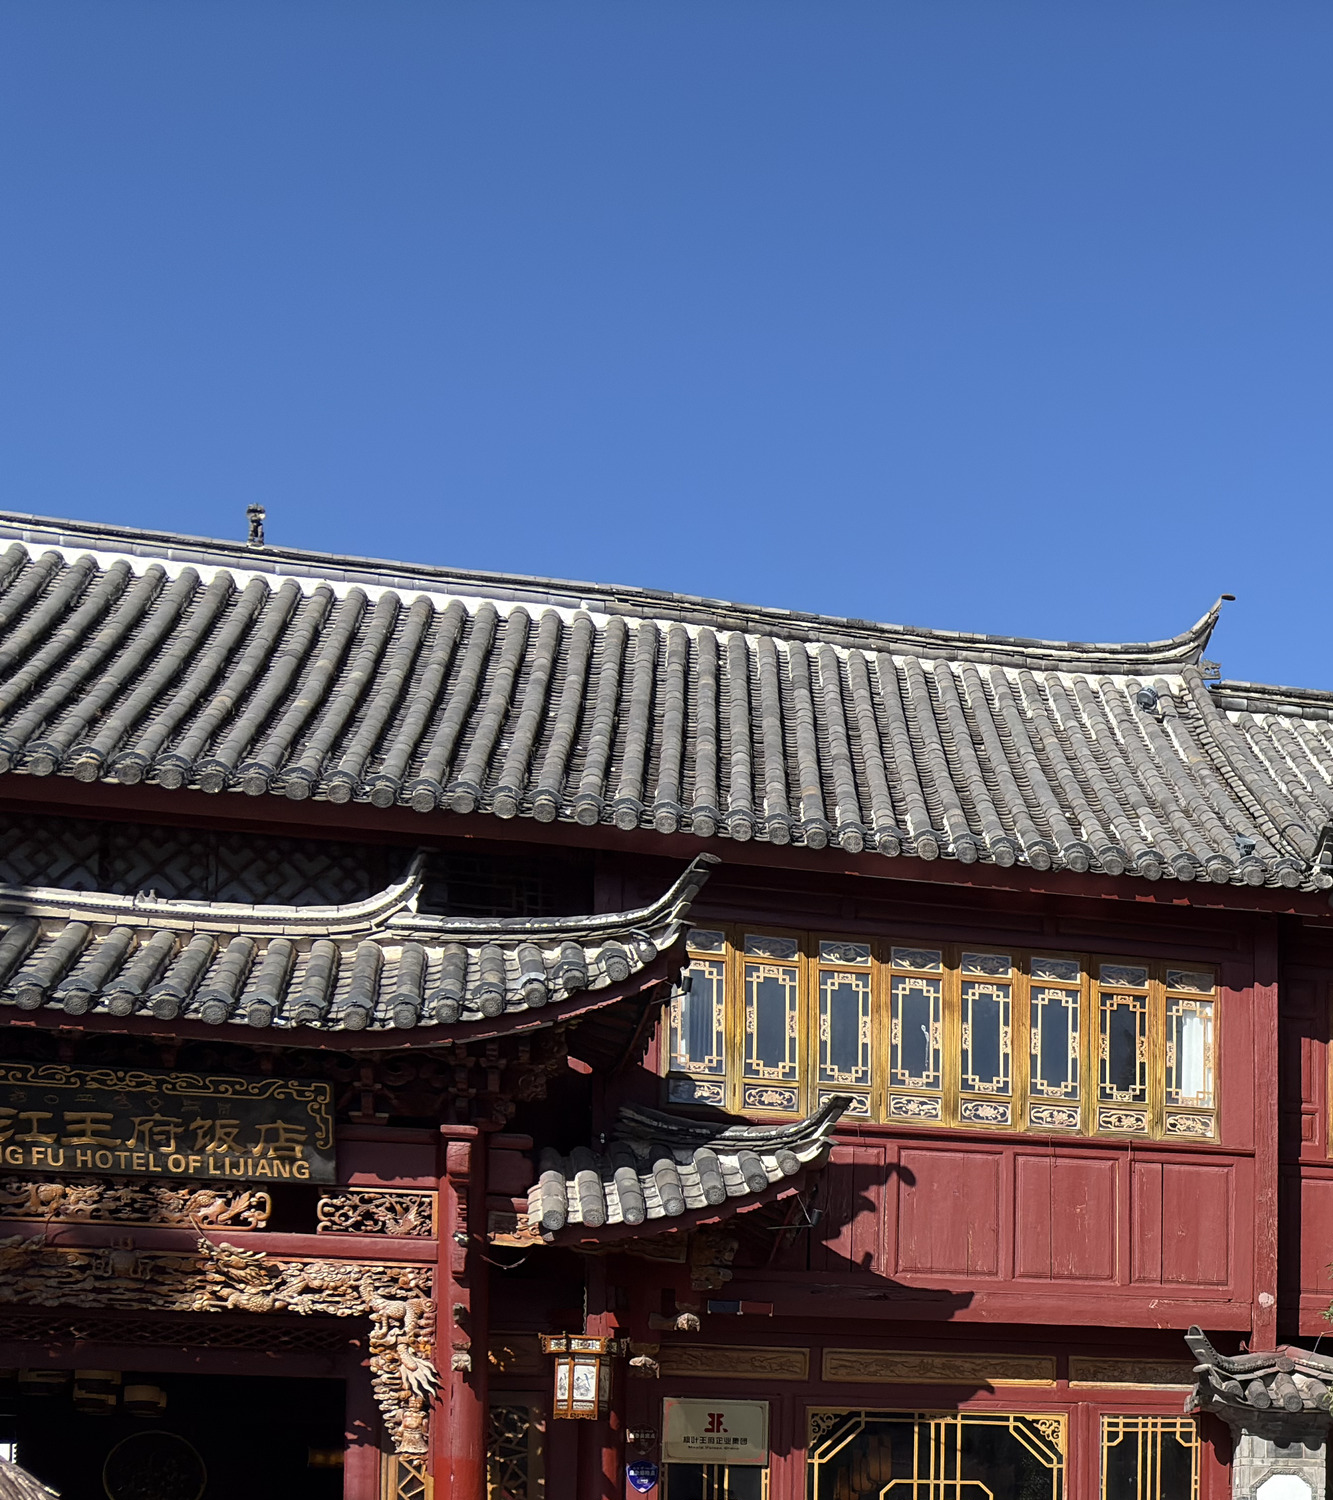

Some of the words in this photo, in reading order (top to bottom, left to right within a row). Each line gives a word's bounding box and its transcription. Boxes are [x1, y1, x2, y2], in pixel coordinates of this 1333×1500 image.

[31, 1146, 65, 1167] FU
[76, 1149, 162, 1172] HOTEL
[167, 1154, 203, 1173] OF
[208, 1156, 311, 1179] LIJIANG
